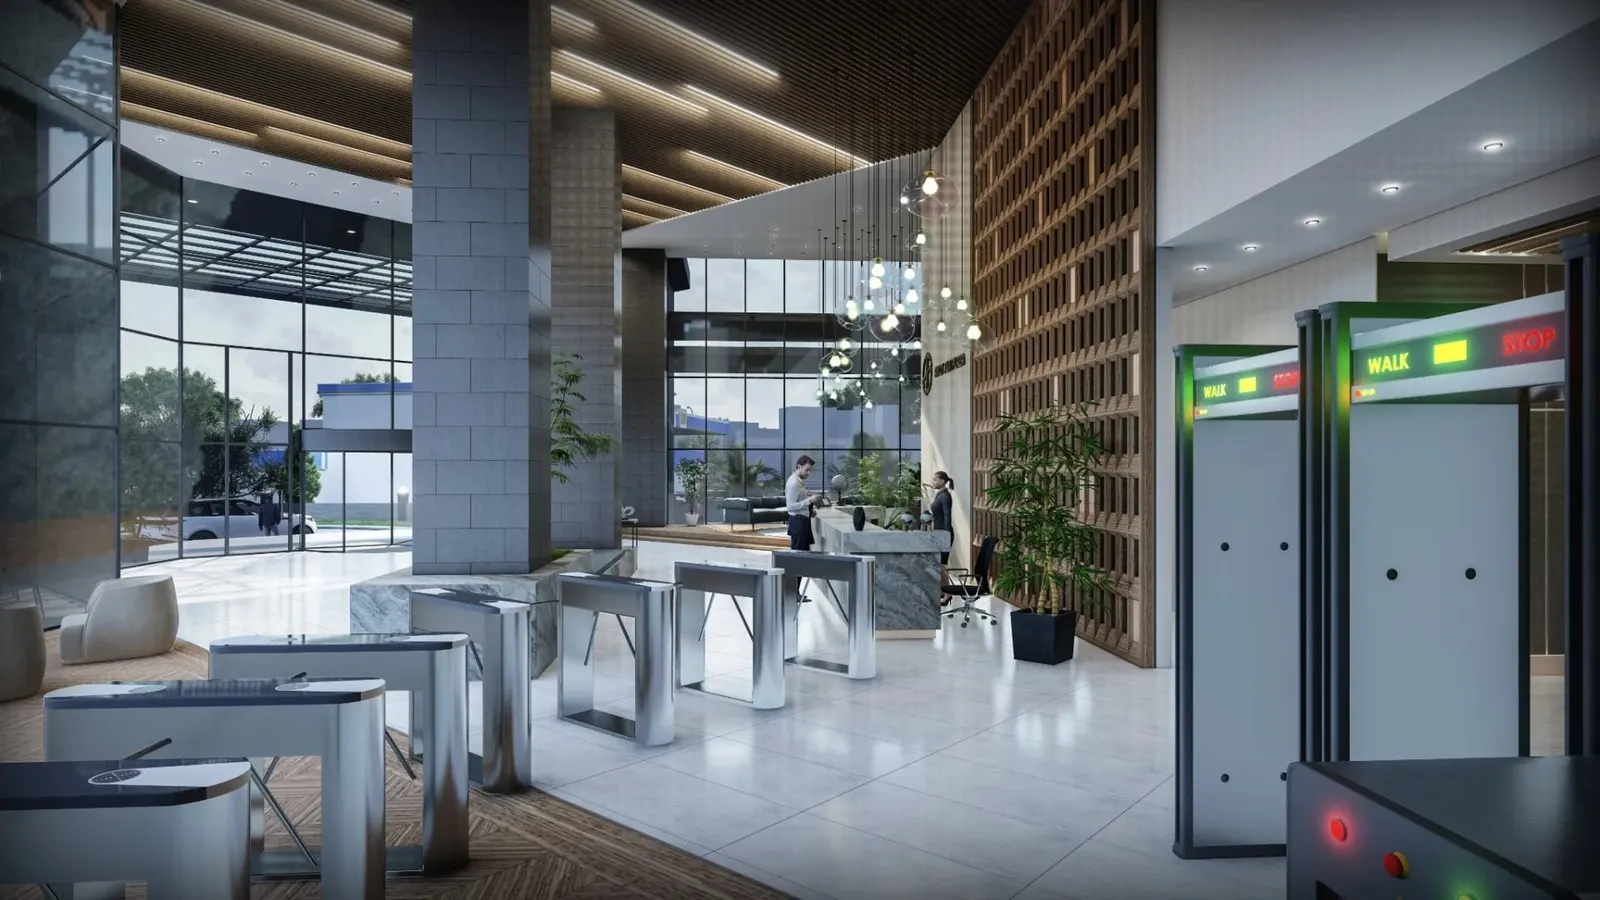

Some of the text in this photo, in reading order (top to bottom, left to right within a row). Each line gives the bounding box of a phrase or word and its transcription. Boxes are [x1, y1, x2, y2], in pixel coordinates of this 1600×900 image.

[1367, 329, 1556, 374] WALK STOP
[1203, 383, 1227, 399] WALK
